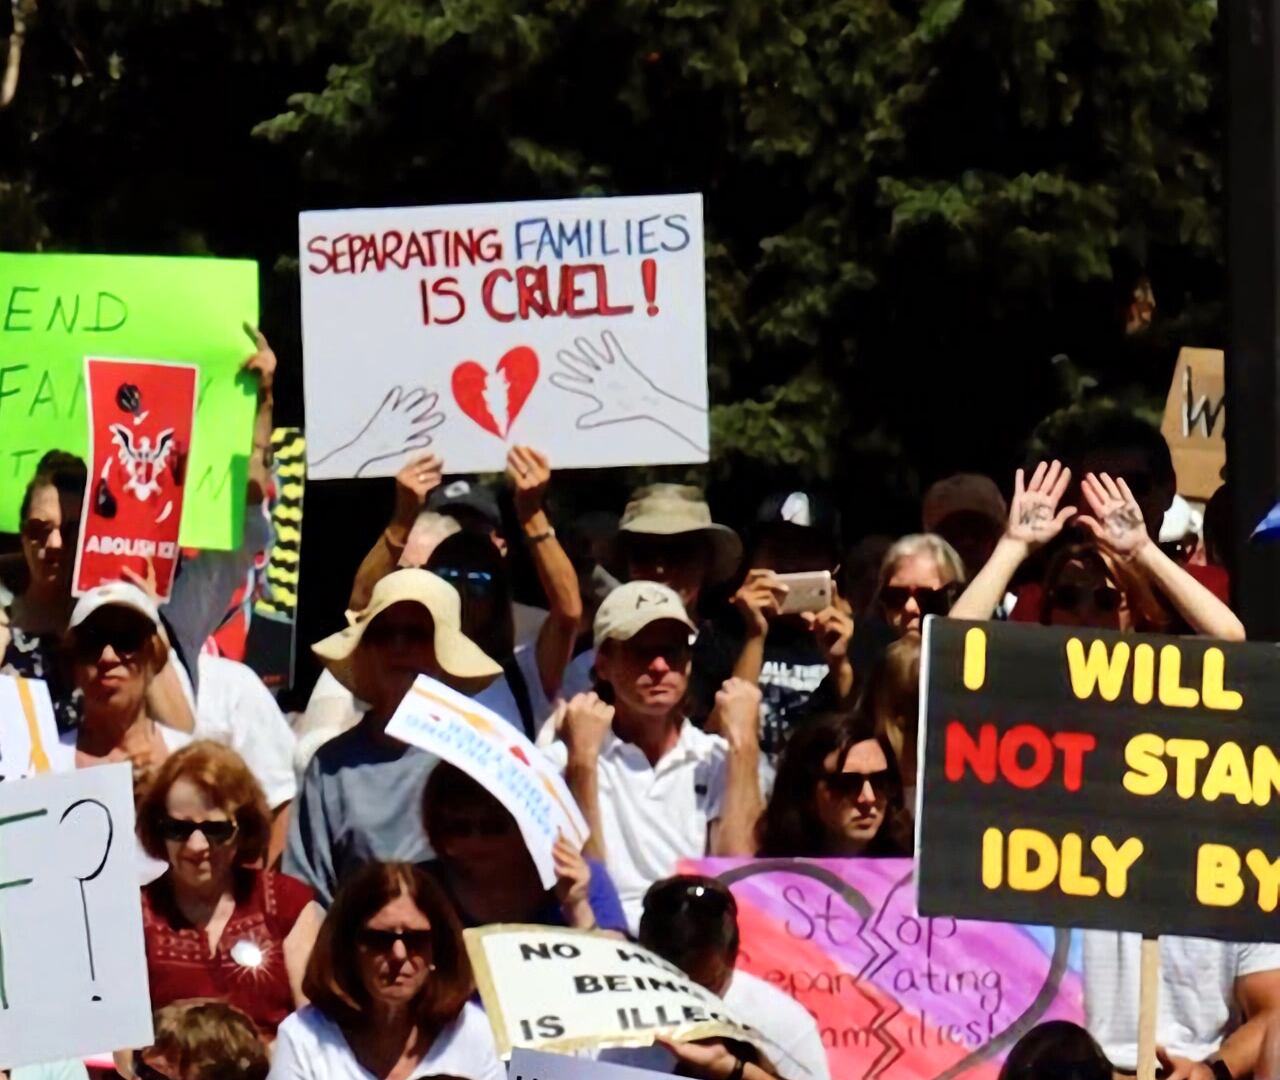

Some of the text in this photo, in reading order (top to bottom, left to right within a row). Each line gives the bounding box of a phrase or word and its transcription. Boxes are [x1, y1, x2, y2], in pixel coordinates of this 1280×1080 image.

[306, 213, 692, 275] SEPARATING FAMILIES
[3, 286, 129, 335] END
[419, 277, 466, 325] IS
[85, 534, 157, 559] ABOLISH
[963, 626, 1244, 711] I WILL
[944, 720, 1096, 793] NOT
[981, 827, 1280, 913] IDLY BY
[518, 942, 582, 962] NO
[519, 1014, 565, 1041] IS
